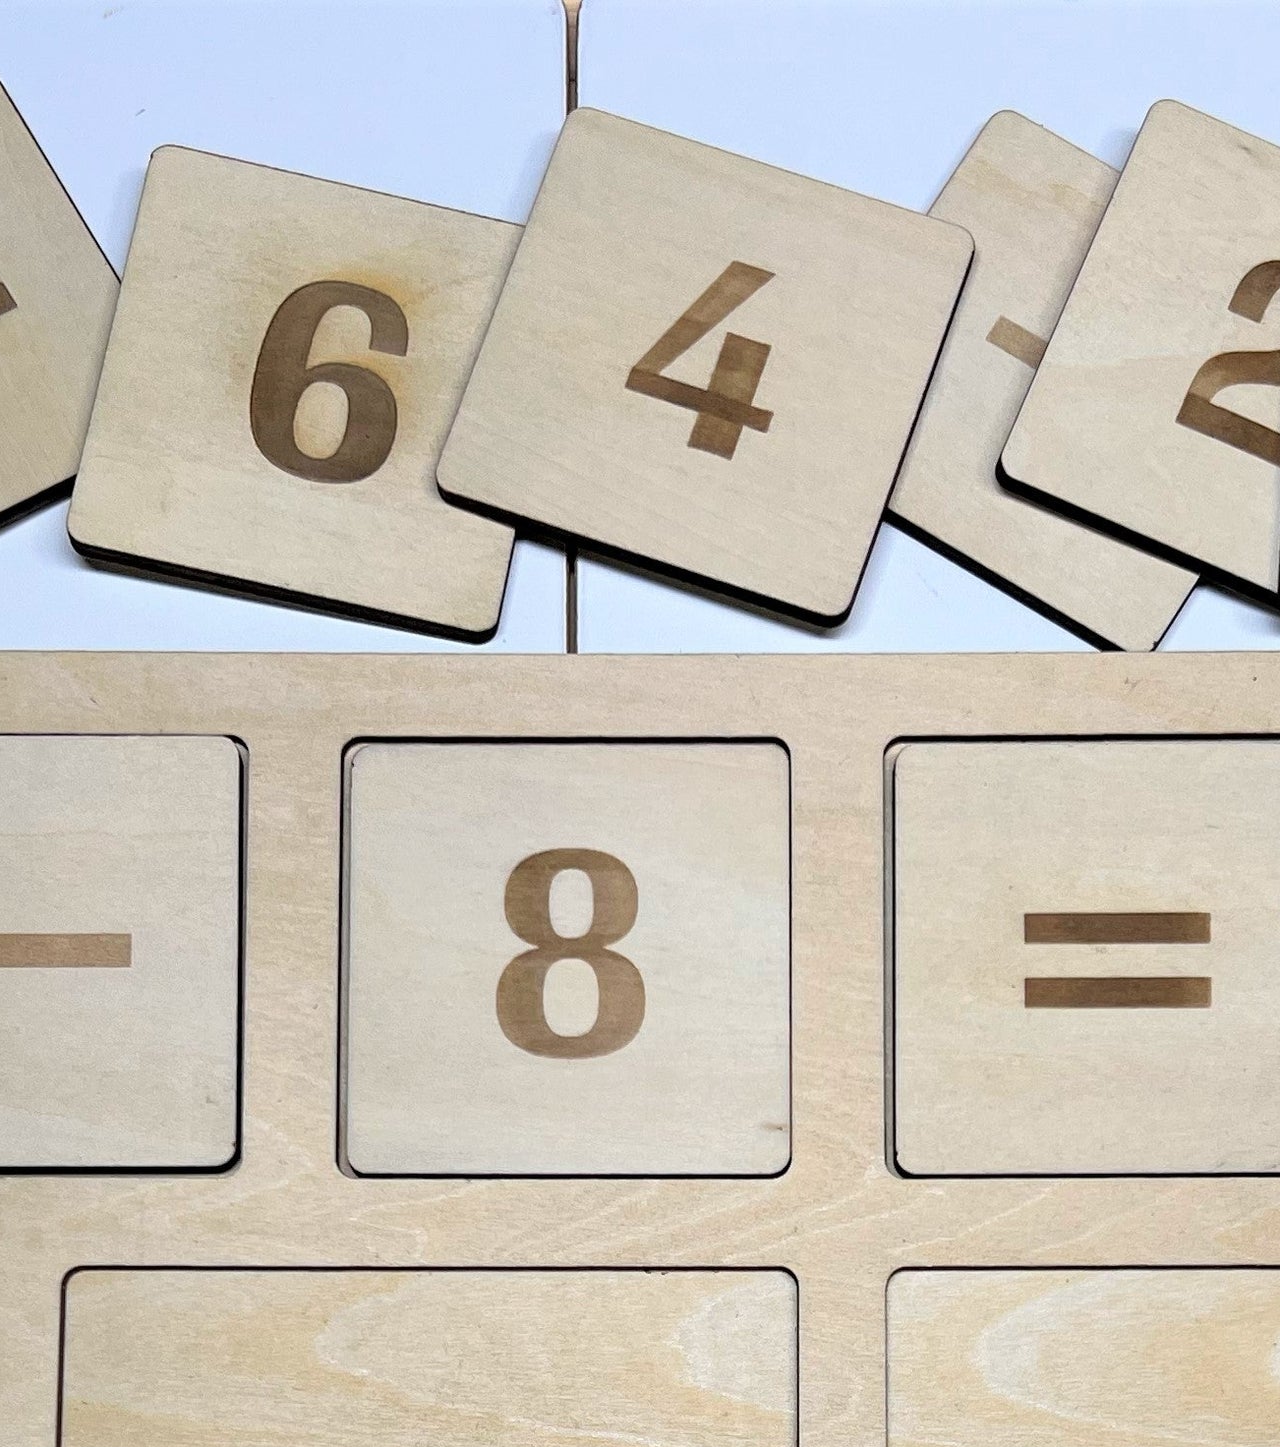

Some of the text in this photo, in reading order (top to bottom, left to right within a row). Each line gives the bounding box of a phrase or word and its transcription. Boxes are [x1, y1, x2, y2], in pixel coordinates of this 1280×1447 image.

[249, 279, 410, 485] 6
[625, 260, 776, 461] 4
[495, 847, 645, 1060] 8
[1024, 911, 1212, 1009] =
